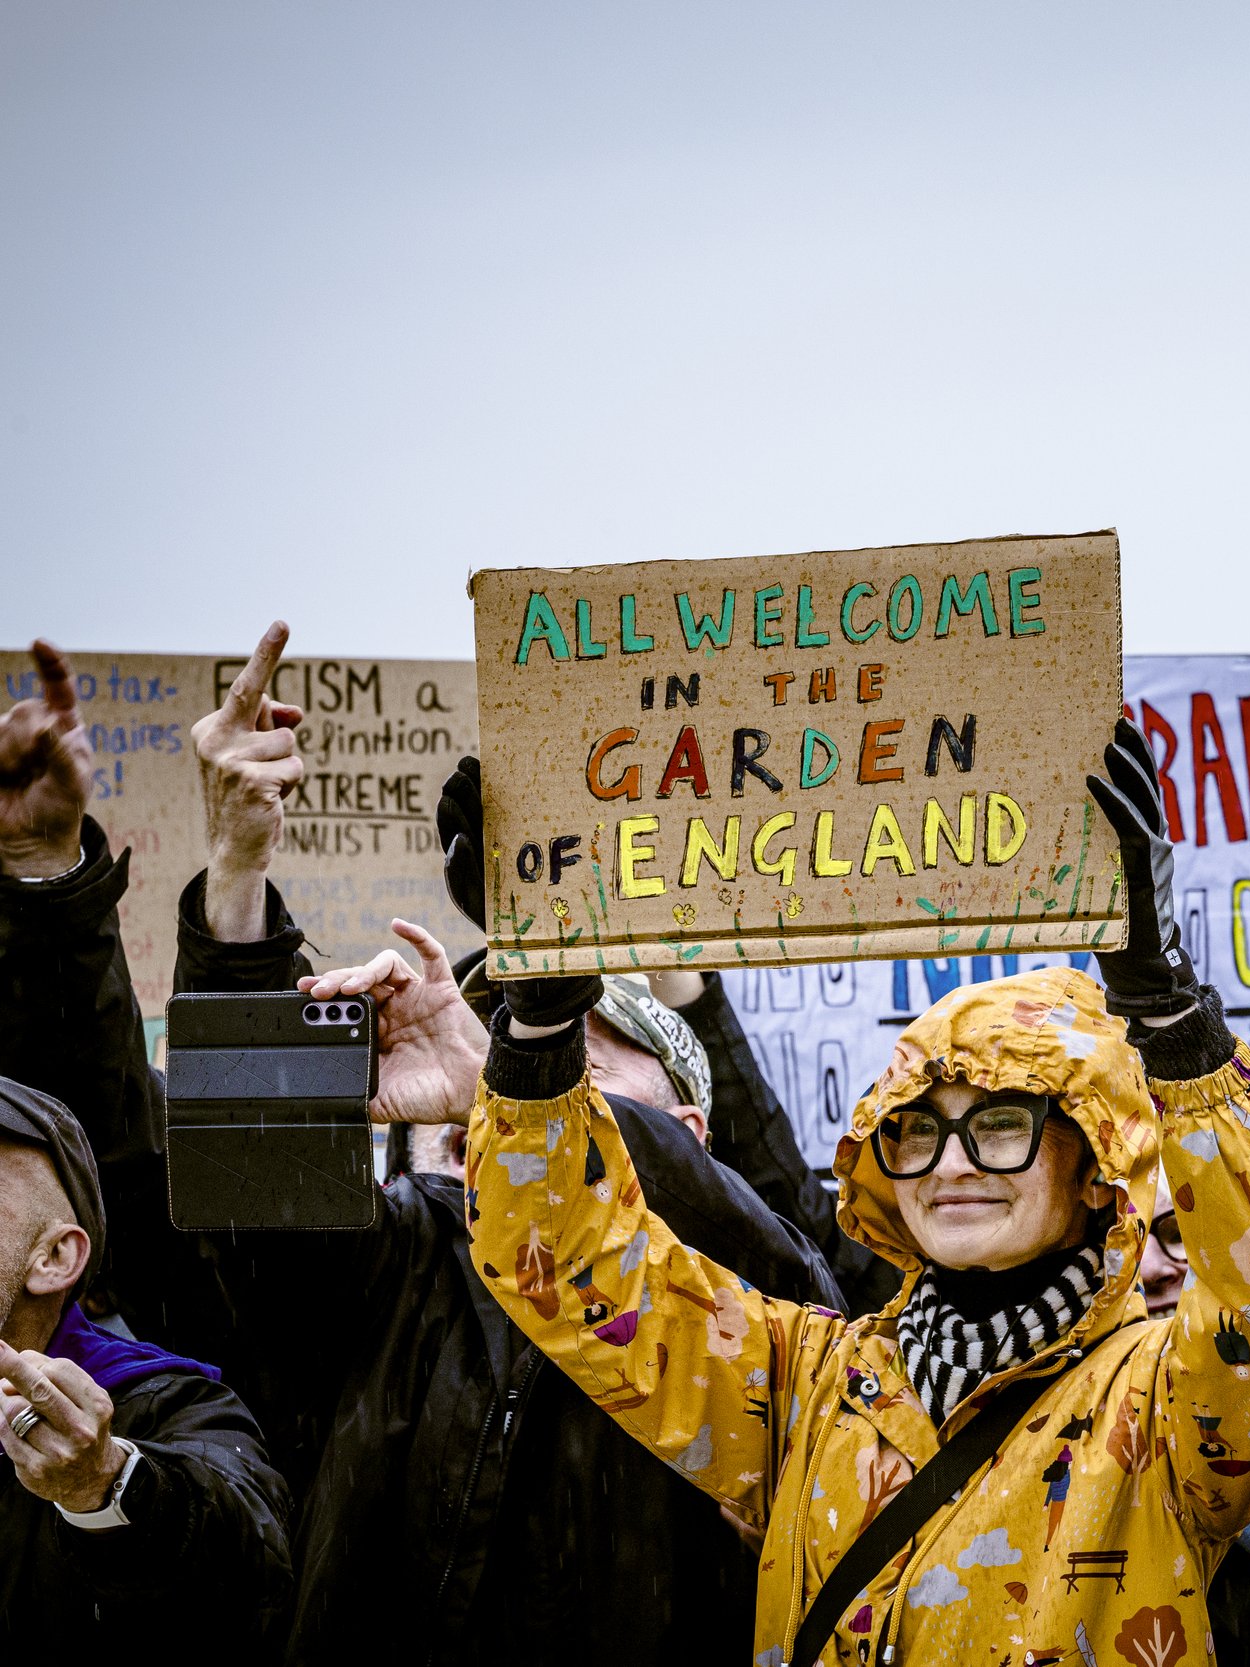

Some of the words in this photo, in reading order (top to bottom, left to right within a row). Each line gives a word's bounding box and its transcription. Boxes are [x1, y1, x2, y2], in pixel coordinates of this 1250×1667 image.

[513, 590, 654, 665] ALL
[675, 566, 1047, 653] WELCOME
[213, 659, 383, 715] FCISM
[416, 681, 452, 712] a
[640, 672, 701, 710] IN
[763, 662, 884, 707] THE
[89, 718, 184, 754] naires
[585, 713, 978, 802] GARDEN
[283, 772, 424, 814] XTREME
[515, 834, 582, 886] OF
[612, 791, 1029, 901] ENGLAND
